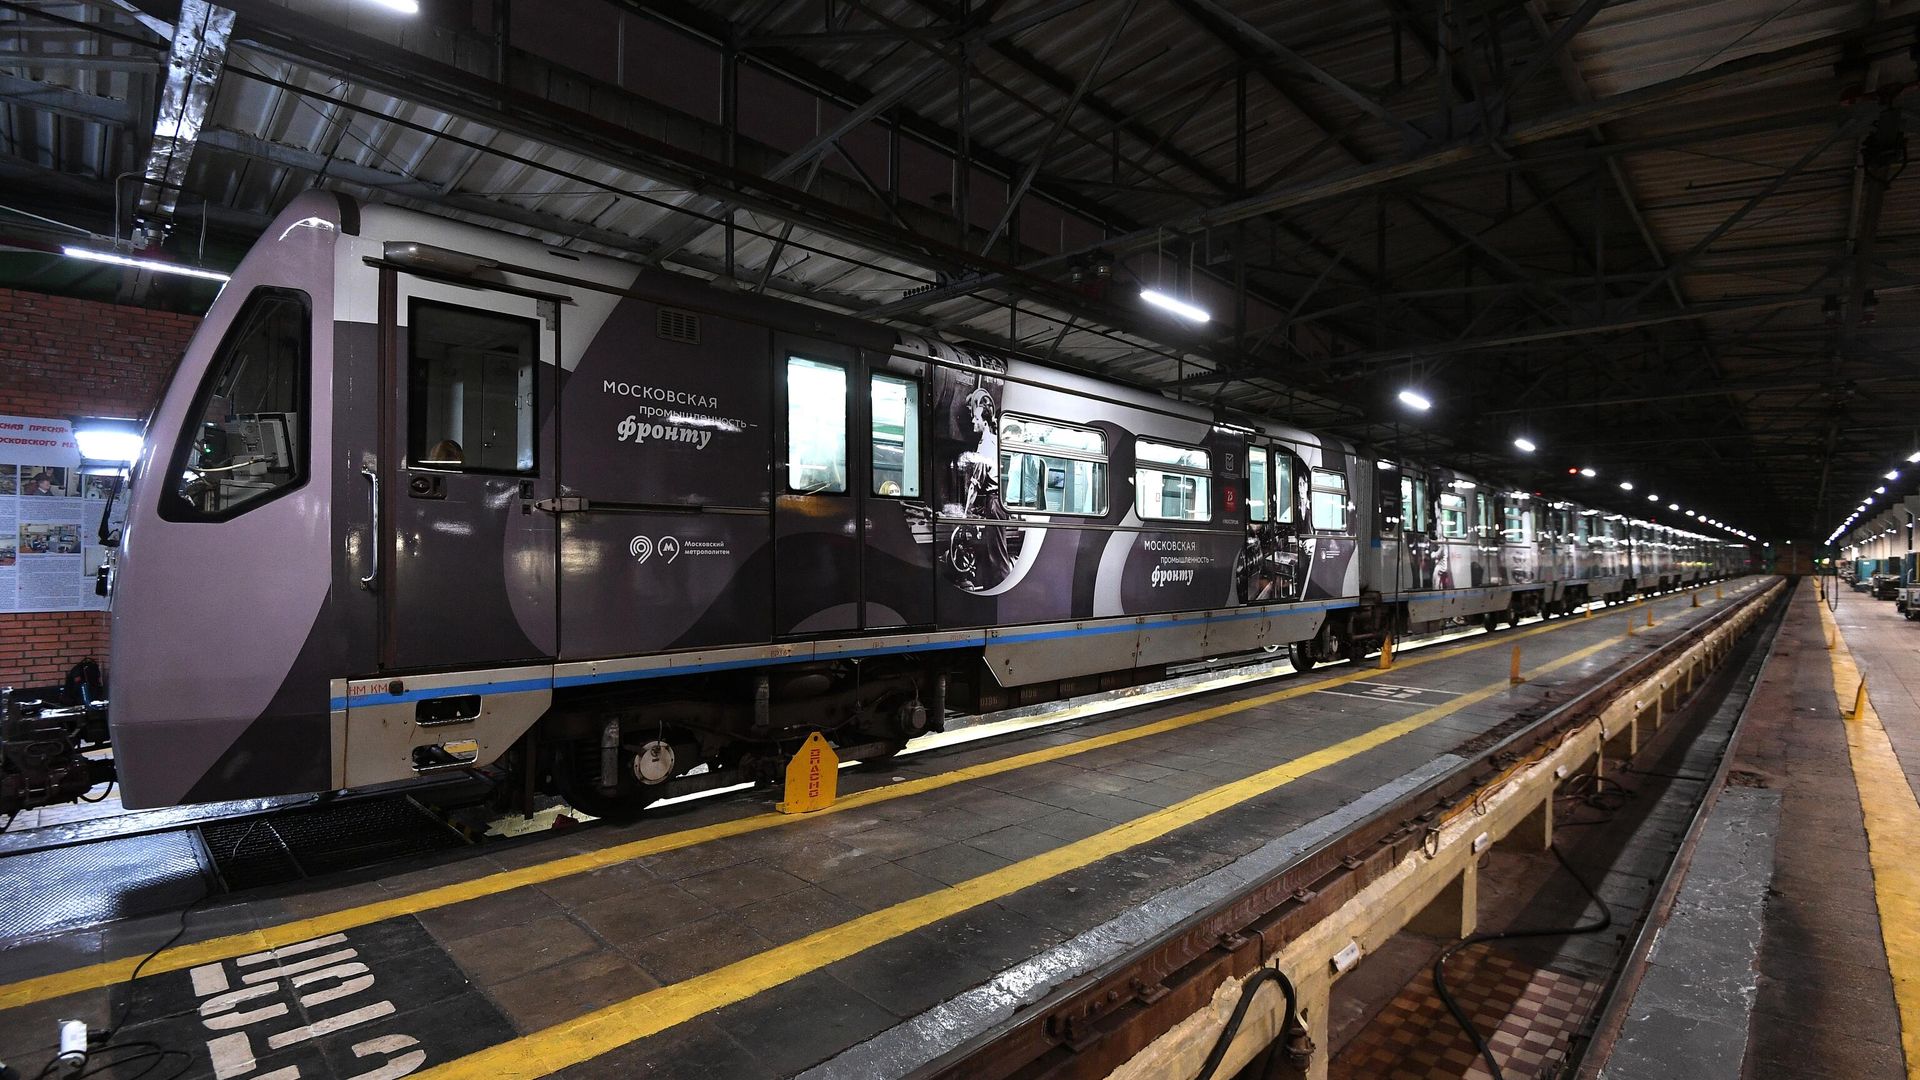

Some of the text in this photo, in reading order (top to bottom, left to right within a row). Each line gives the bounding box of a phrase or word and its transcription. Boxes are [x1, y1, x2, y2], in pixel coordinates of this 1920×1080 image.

[603, 380, 717, 409] МОСКОВСКАЯ
[617, 415, 711, 450] фронту
[1144, 540, 1196, 551] МОСКОВСКАЯ
[1151, 565, 1194, 587] фронту
[808, 748, 820, 798] ОПАСНО
